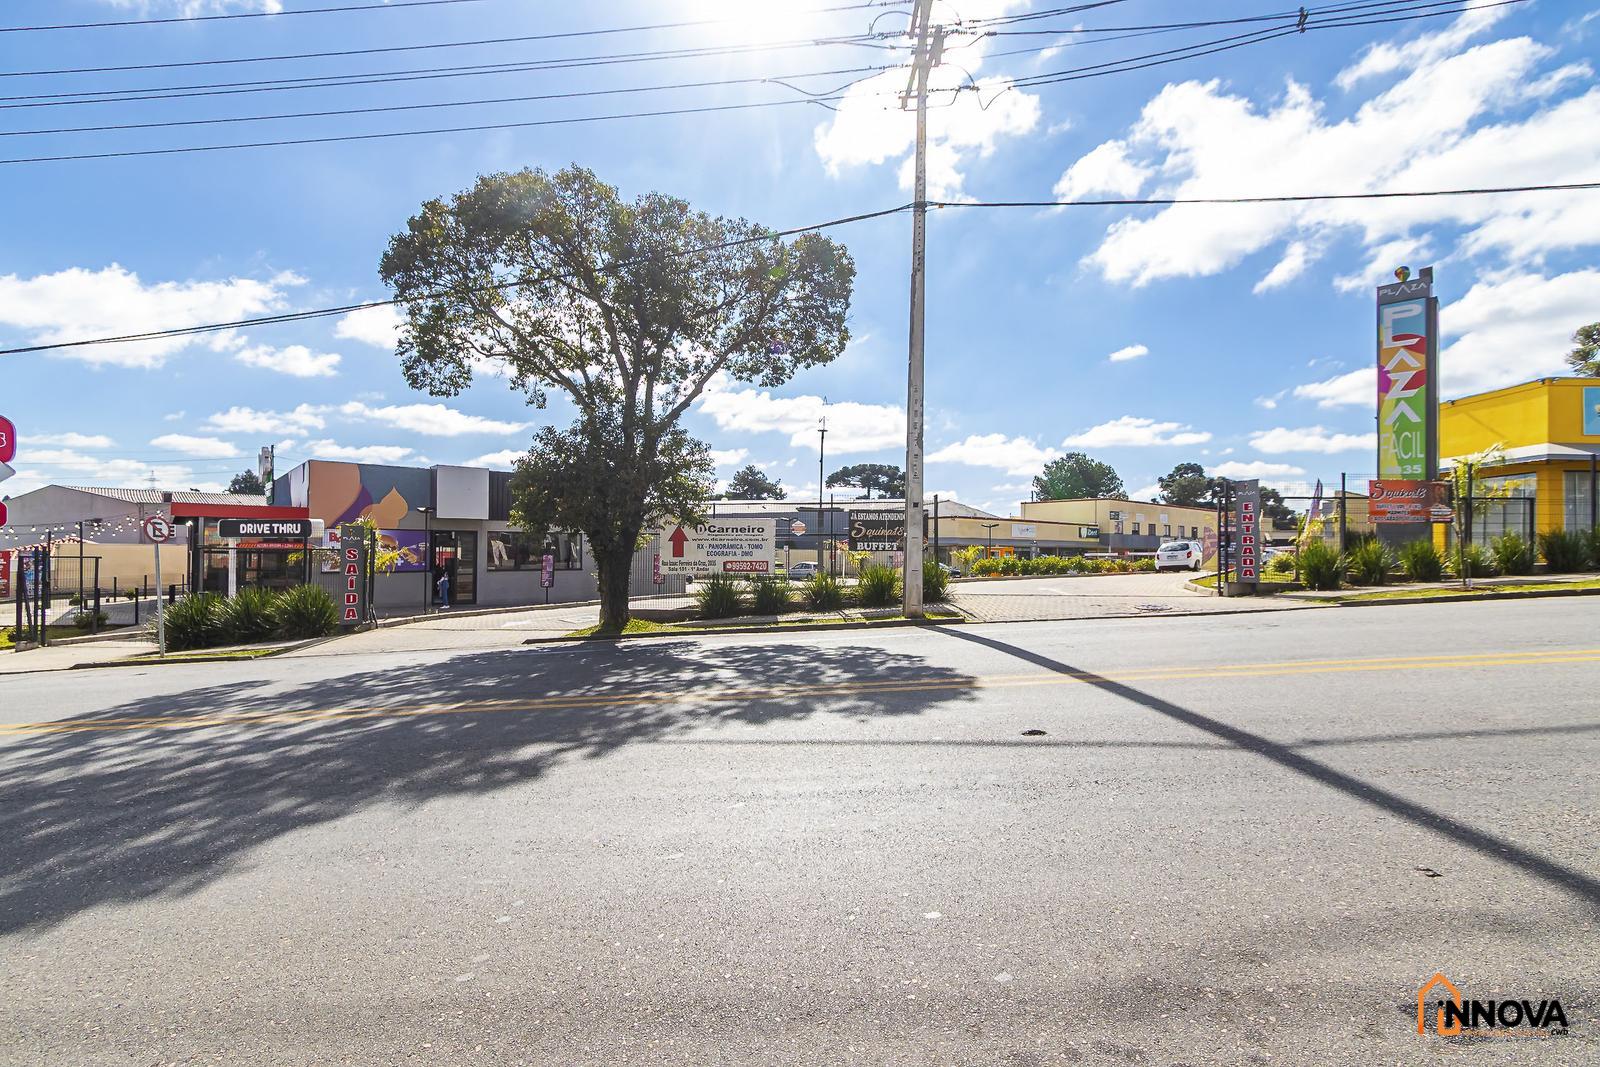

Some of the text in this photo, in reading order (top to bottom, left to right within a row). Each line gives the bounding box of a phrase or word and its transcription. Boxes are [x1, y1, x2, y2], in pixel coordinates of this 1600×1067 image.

[1380, 282, 1427, 296] PLAZA
[858, 512, 879, 520] ESTAMOS
[239, 523, 301, 534] DRIVE THRU
[707, 525, 765, 533] Carneiro
[1242, 502, 1255, 578] ENTRADA
[709, 542, 743, 550] PANORÂMICA
[856, 542, 899, 551] BUFFET
[344, 548, 359, 620] SAÍDA
